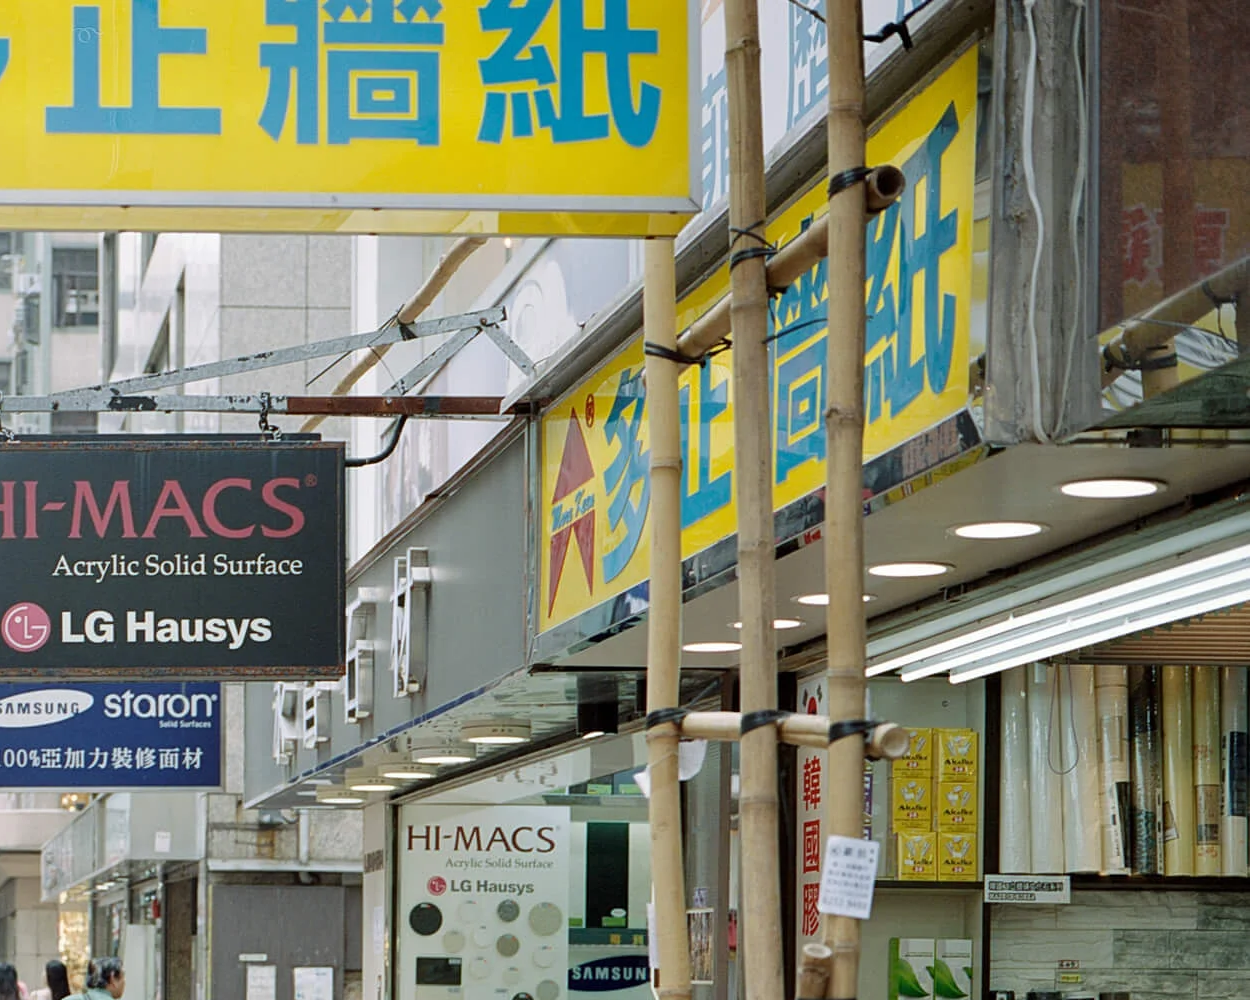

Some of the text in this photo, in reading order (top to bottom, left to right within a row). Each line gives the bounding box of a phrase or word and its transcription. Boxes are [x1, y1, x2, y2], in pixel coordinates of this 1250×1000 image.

[52, 553, 303, 584] Acrylic Solid Surface
[61, 610, 272, 649] LG Hausys
[104, 689, 213, 719] staron
[159, 719, 211, 729] Solid Surfaces
[407, 825, 557, 853] HI-MACS
[445, 857, 554, 871] Acrylic Solid Surface
[450, 879, 535, 895] LG Hausys
[572, 966, 647, 981] SAMSUN
